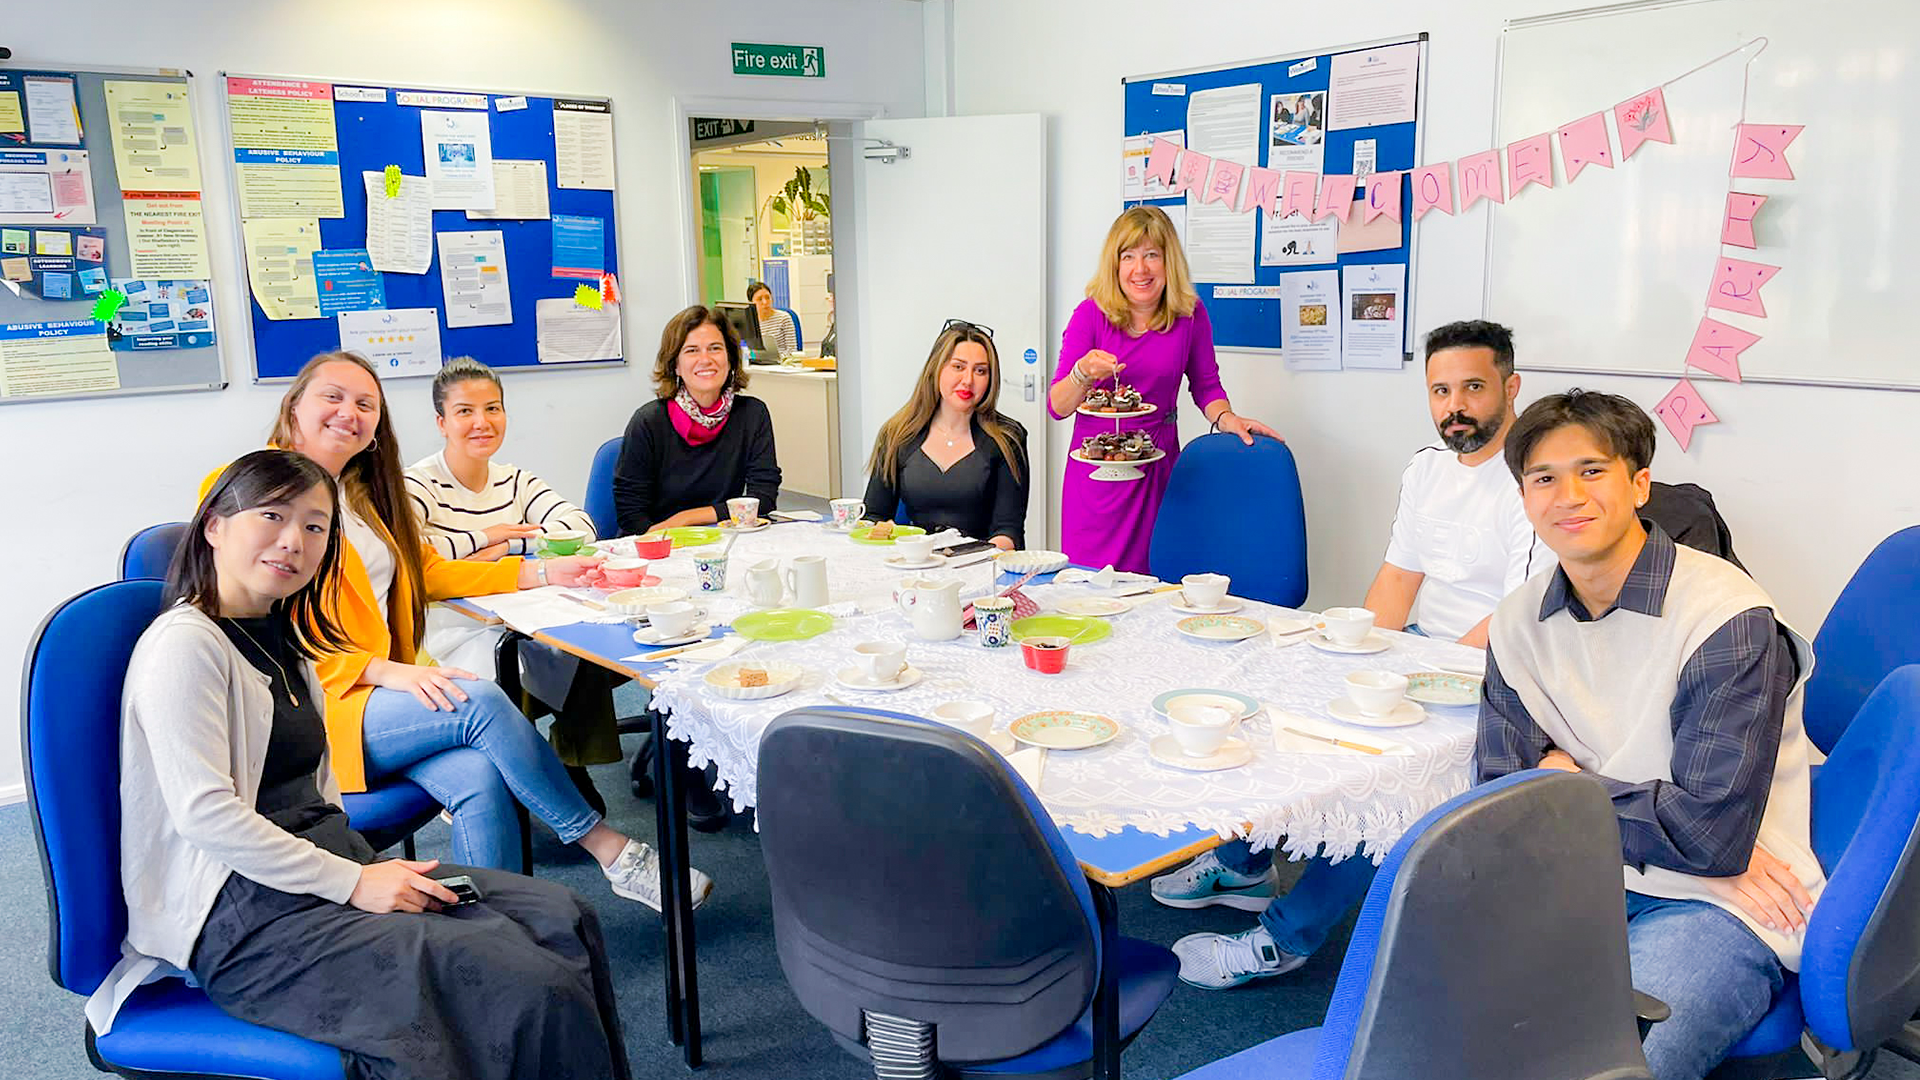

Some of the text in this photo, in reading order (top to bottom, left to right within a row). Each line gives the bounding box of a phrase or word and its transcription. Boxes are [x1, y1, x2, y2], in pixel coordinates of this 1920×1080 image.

[733, 49, 798, 70] Fire exit
[252, 80, 301, 88] ATTENDANCE
[398, 94, 487, 106] SOCIAL PROGRAMME
[498, 100, 526, 109] Weekend
[697, 121, 719, 138] EXIT
[1252, 143, 1537, 210] WELCOME
[1668, 137, 1777, 431] PARTY
[1215, 288, 1238, 296] SOCIAL
[47, 320, 95, 329] BEHAVIOUR
